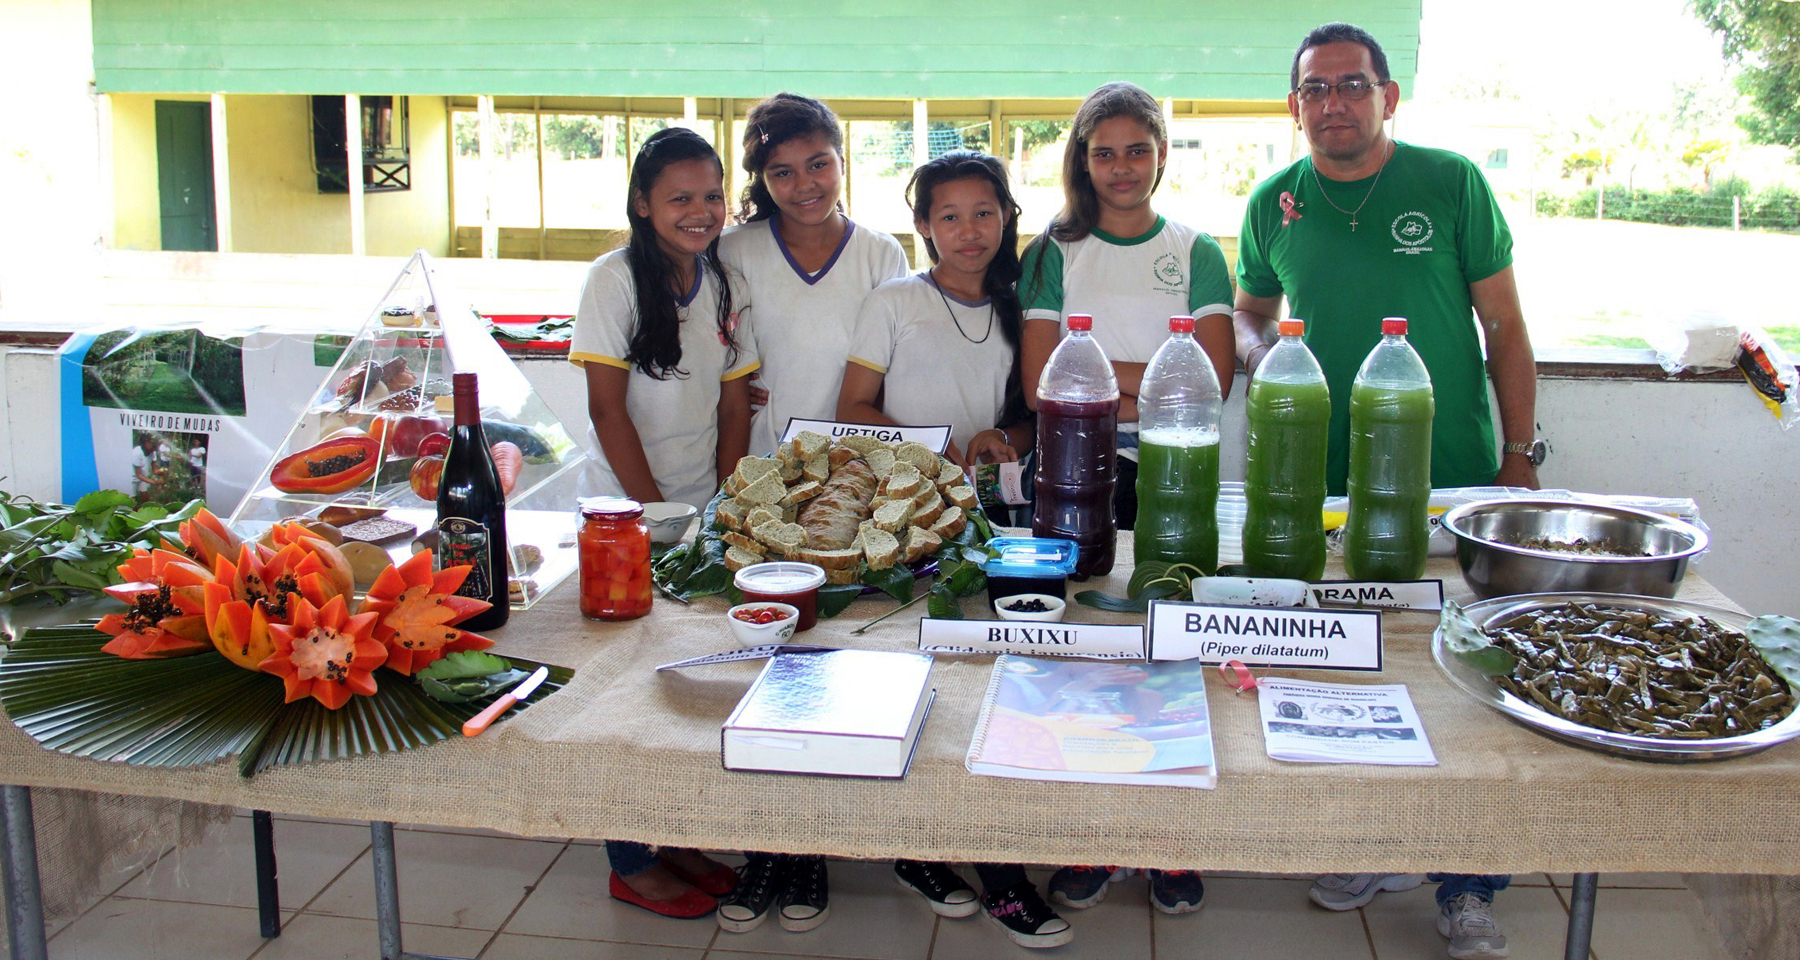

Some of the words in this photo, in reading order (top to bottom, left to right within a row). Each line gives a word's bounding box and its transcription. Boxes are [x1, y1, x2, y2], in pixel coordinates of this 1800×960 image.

[119, 413, 164, 429] VIVEIRO
[167, 416, 180, 429] DE
[183, 417, 221, 432] MUDAS
[832, 426, 904, 442] URTIGA
[1185, 612, 1347, 639] BANANINHA
[986, 627, 1079, 645] BUXIXU
[1201, 641, 1247, 657] (Piper
[1251, 643, 1329, 660] dilatatum)
[1269, 685, 1329, 694] ALIMENTAÇÃO
